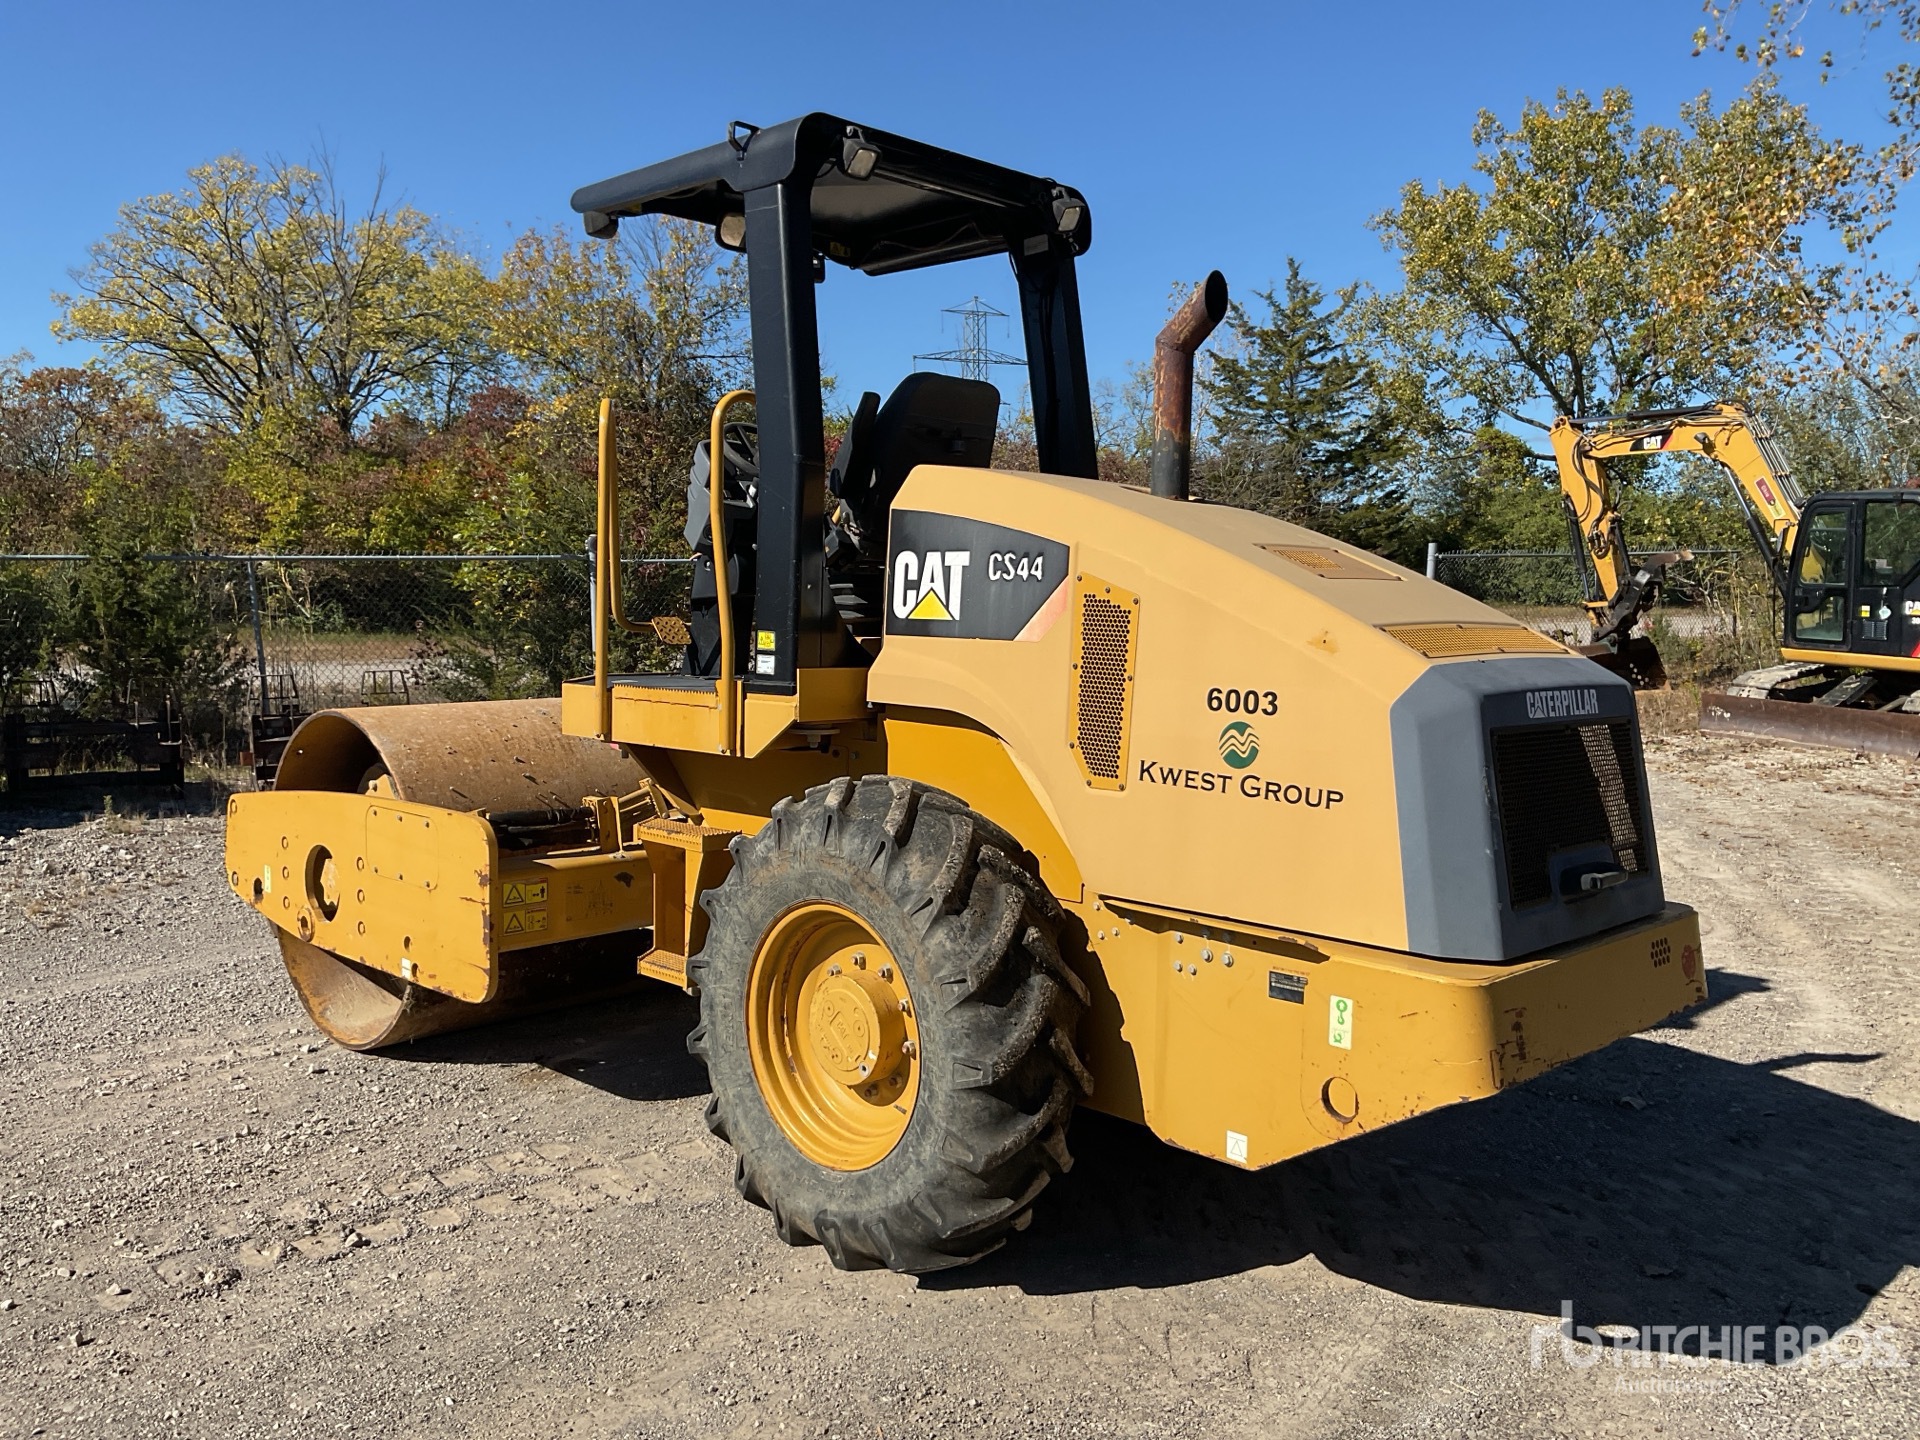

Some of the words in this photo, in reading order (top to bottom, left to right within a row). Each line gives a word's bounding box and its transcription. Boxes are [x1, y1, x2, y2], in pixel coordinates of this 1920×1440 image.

[1643, 435, 1662, 450] CAT
[988, 552, 1043, 582] CS44
[892, 550, 970, 621] CAT
[1206, 687, 1279, 716] 6003
[1526, 688, 1599, 719] CATERPILLAR
